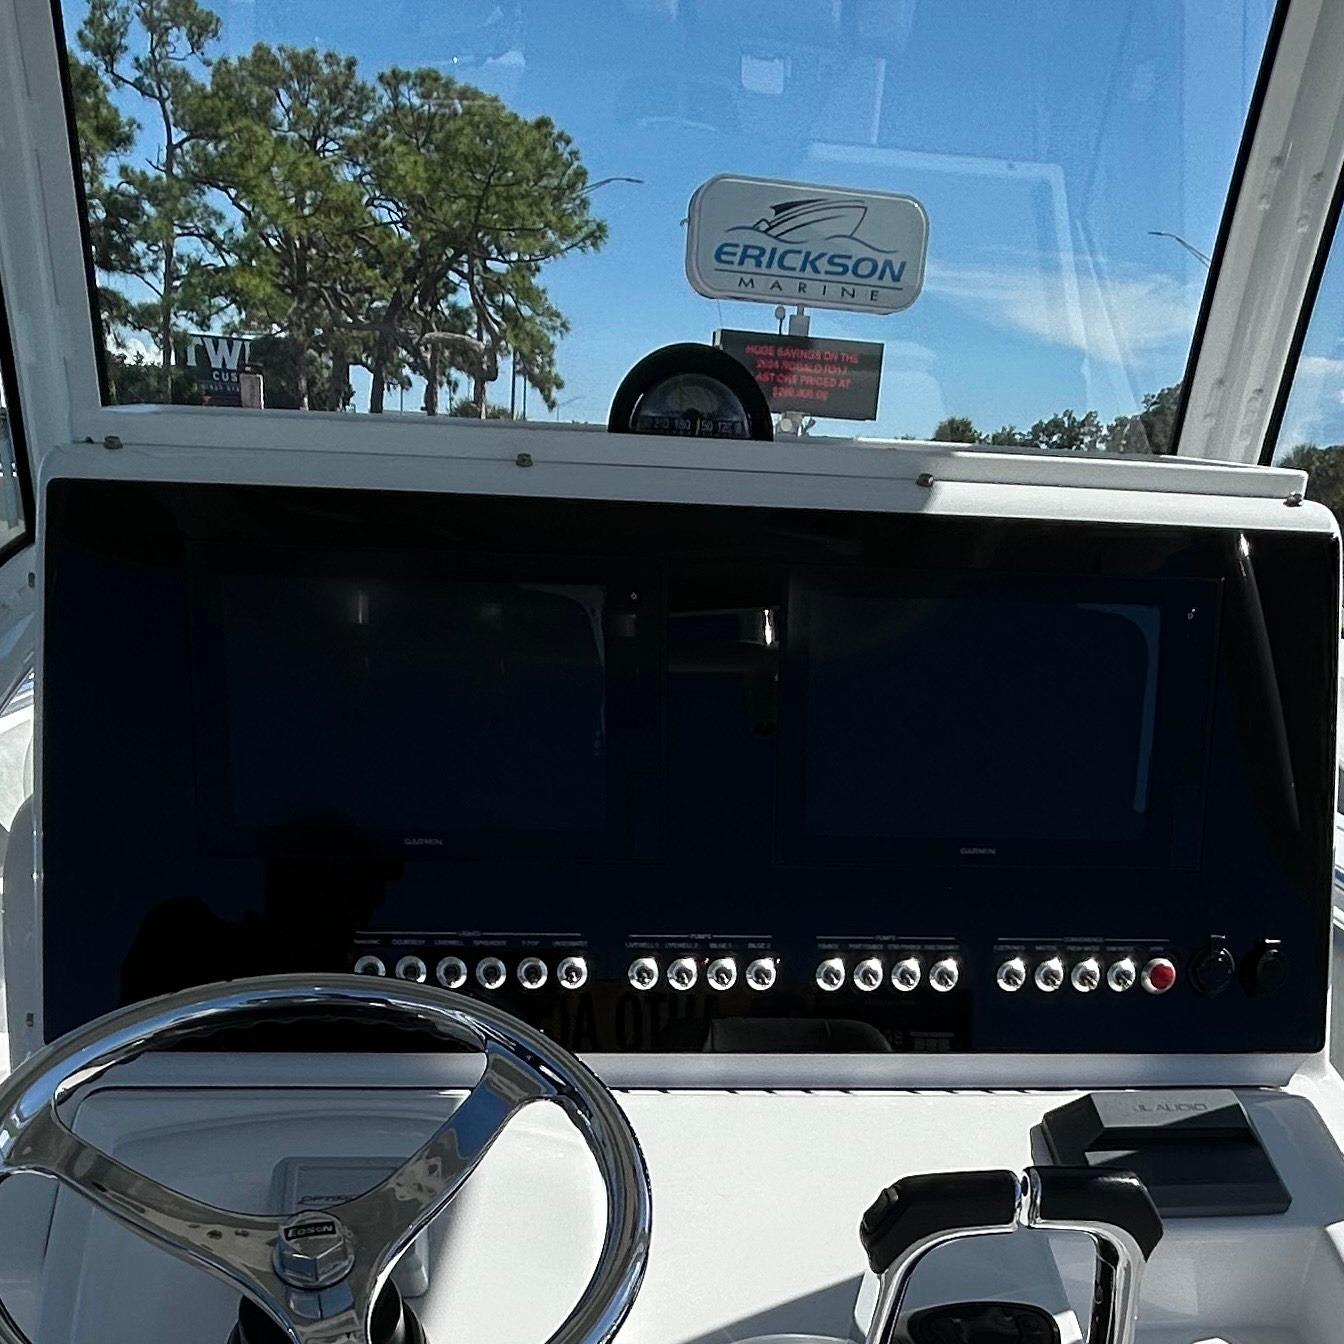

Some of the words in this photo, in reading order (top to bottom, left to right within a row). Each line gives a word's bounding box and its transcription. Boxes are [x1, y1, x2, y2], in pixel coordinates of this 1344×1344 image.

[714, 242, 906, 283] ERICKSON
[739, 276, 880, 301] MARINE
[212, 371, 239, 382] CUS
[753, 372, 775, 382] AST
[287, 1224, 334, 1238] EDSON
